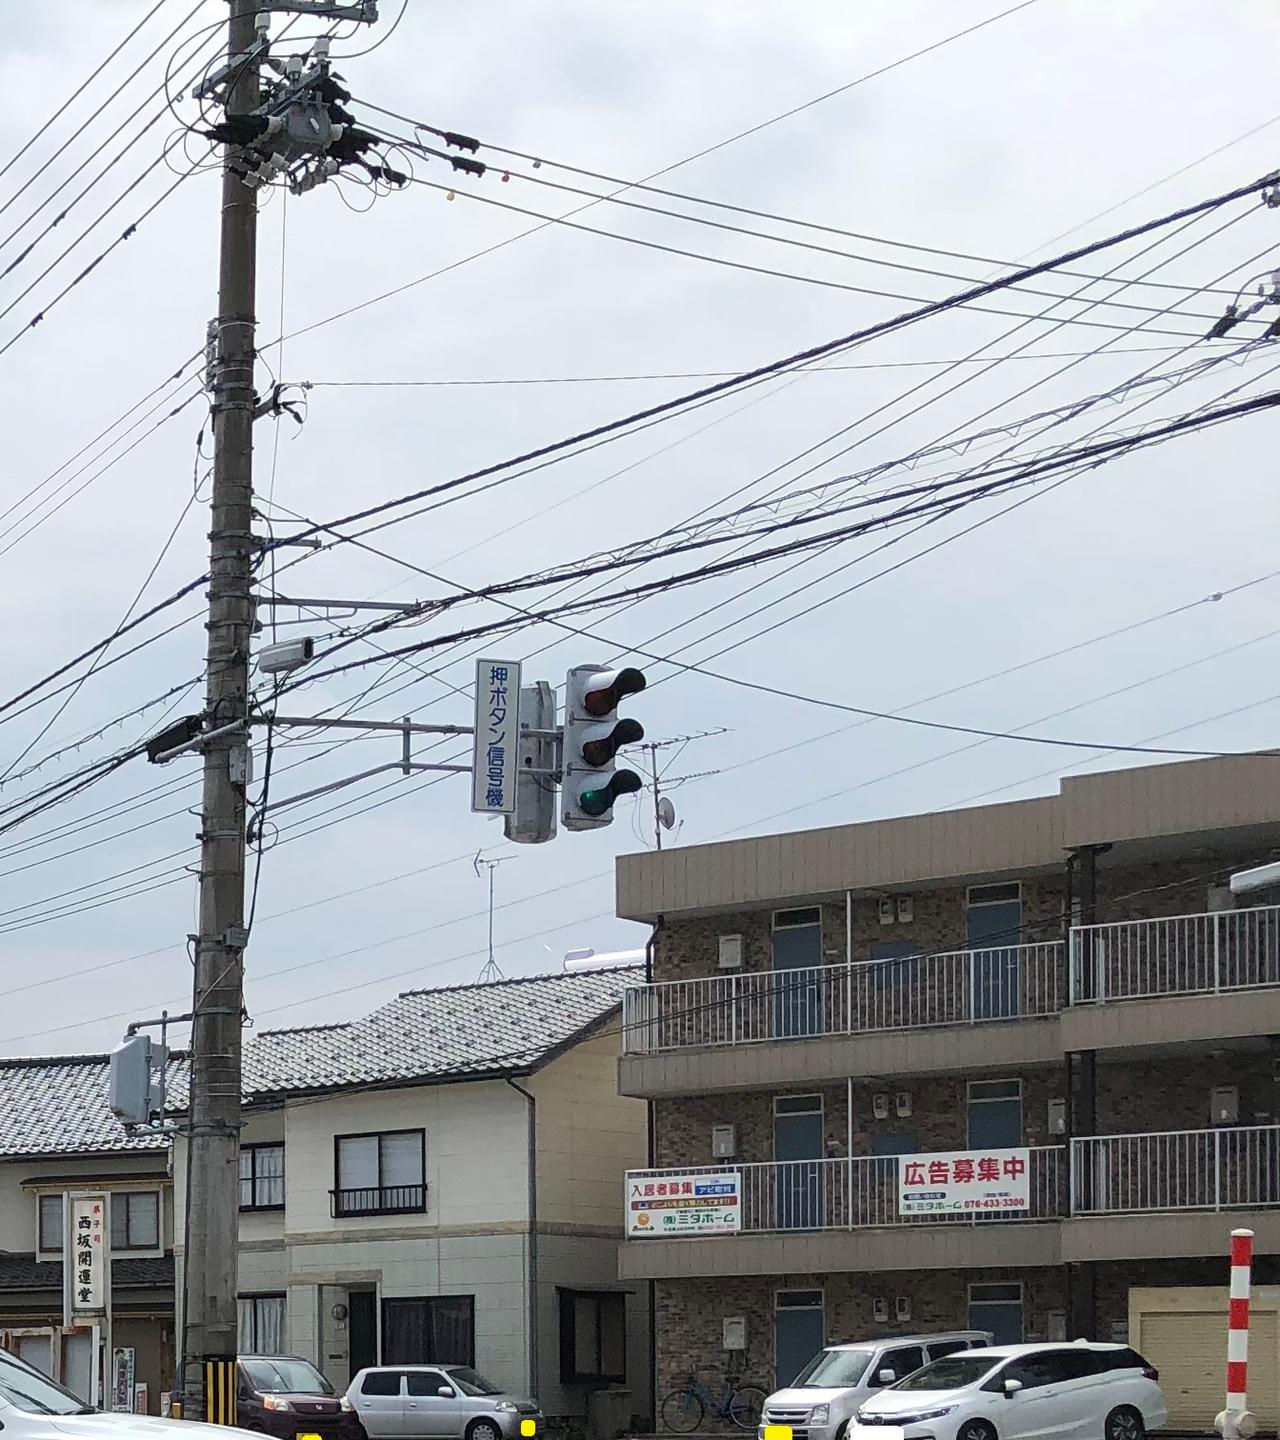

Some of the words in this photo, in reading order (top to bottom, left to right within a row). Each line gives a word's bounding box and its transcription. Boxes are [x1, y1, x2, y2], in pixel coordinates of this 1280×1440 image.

[486, 666, 508, 807] 押ボタン信号機
[903, 1155, 1025, 1186] 広告募集中
[631, 1181, 693, 1197] 入居者募集
[964, 1198, 1025, 1209] 076-433-3300
[77, 1215, 93, 1303] 西坂開運堂
